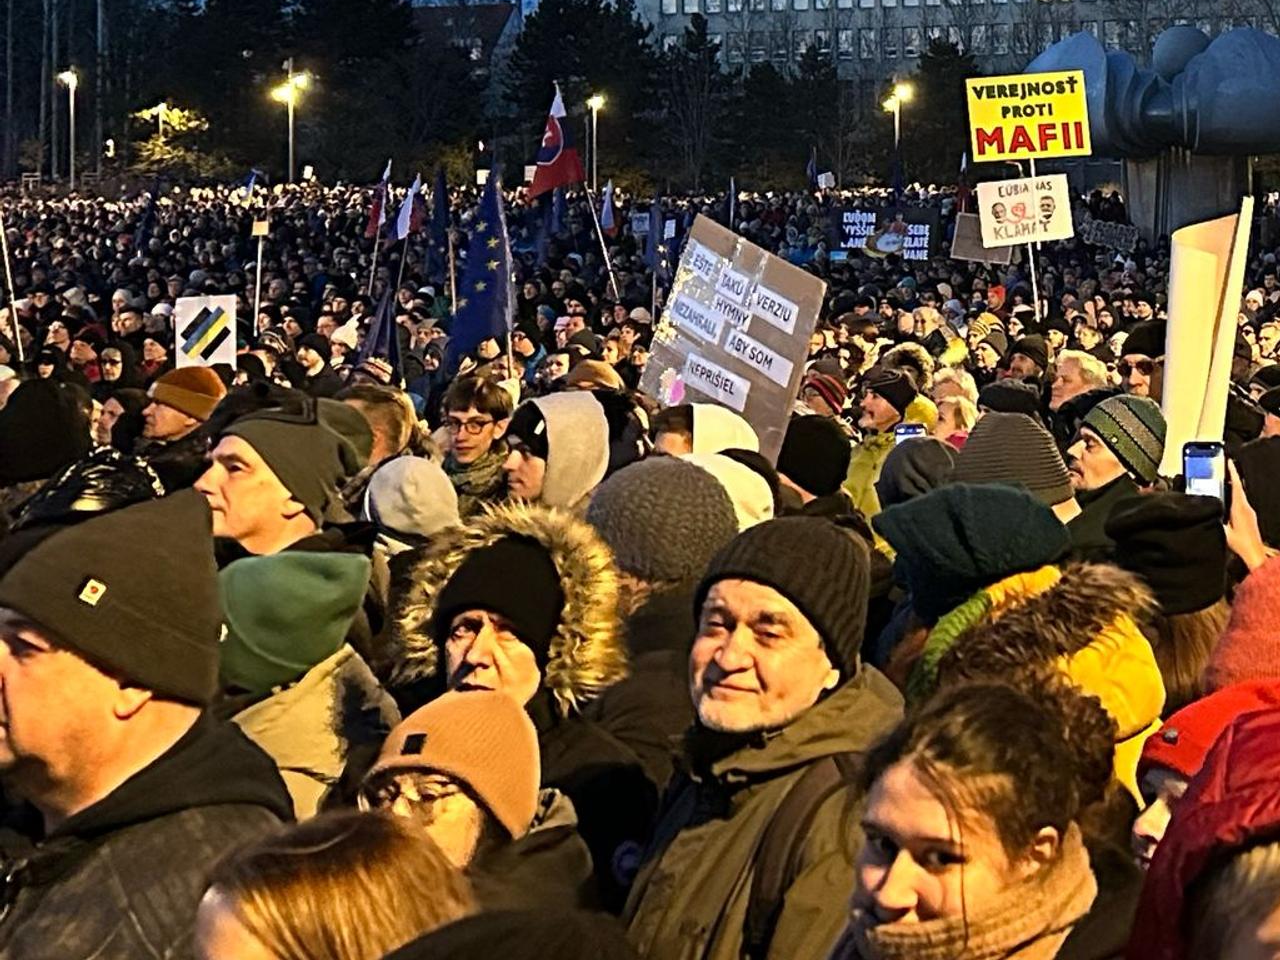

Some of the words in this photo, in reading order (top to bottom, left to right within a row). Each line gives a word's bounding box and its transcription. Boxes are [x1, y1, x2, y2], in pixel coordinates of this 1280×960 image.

[971, 75, 1078, 100] VEREJNOSŤ
[1001, 103, 1053, 119] PROTI
[975, 121, 1084, 155] MAFII
[714, 298, 749, 325] HYMNY
[756, 292, 792, 322] VERZIU
[728, 334, 750, 356] ABY
[749, 346, 774, 371] SOM
